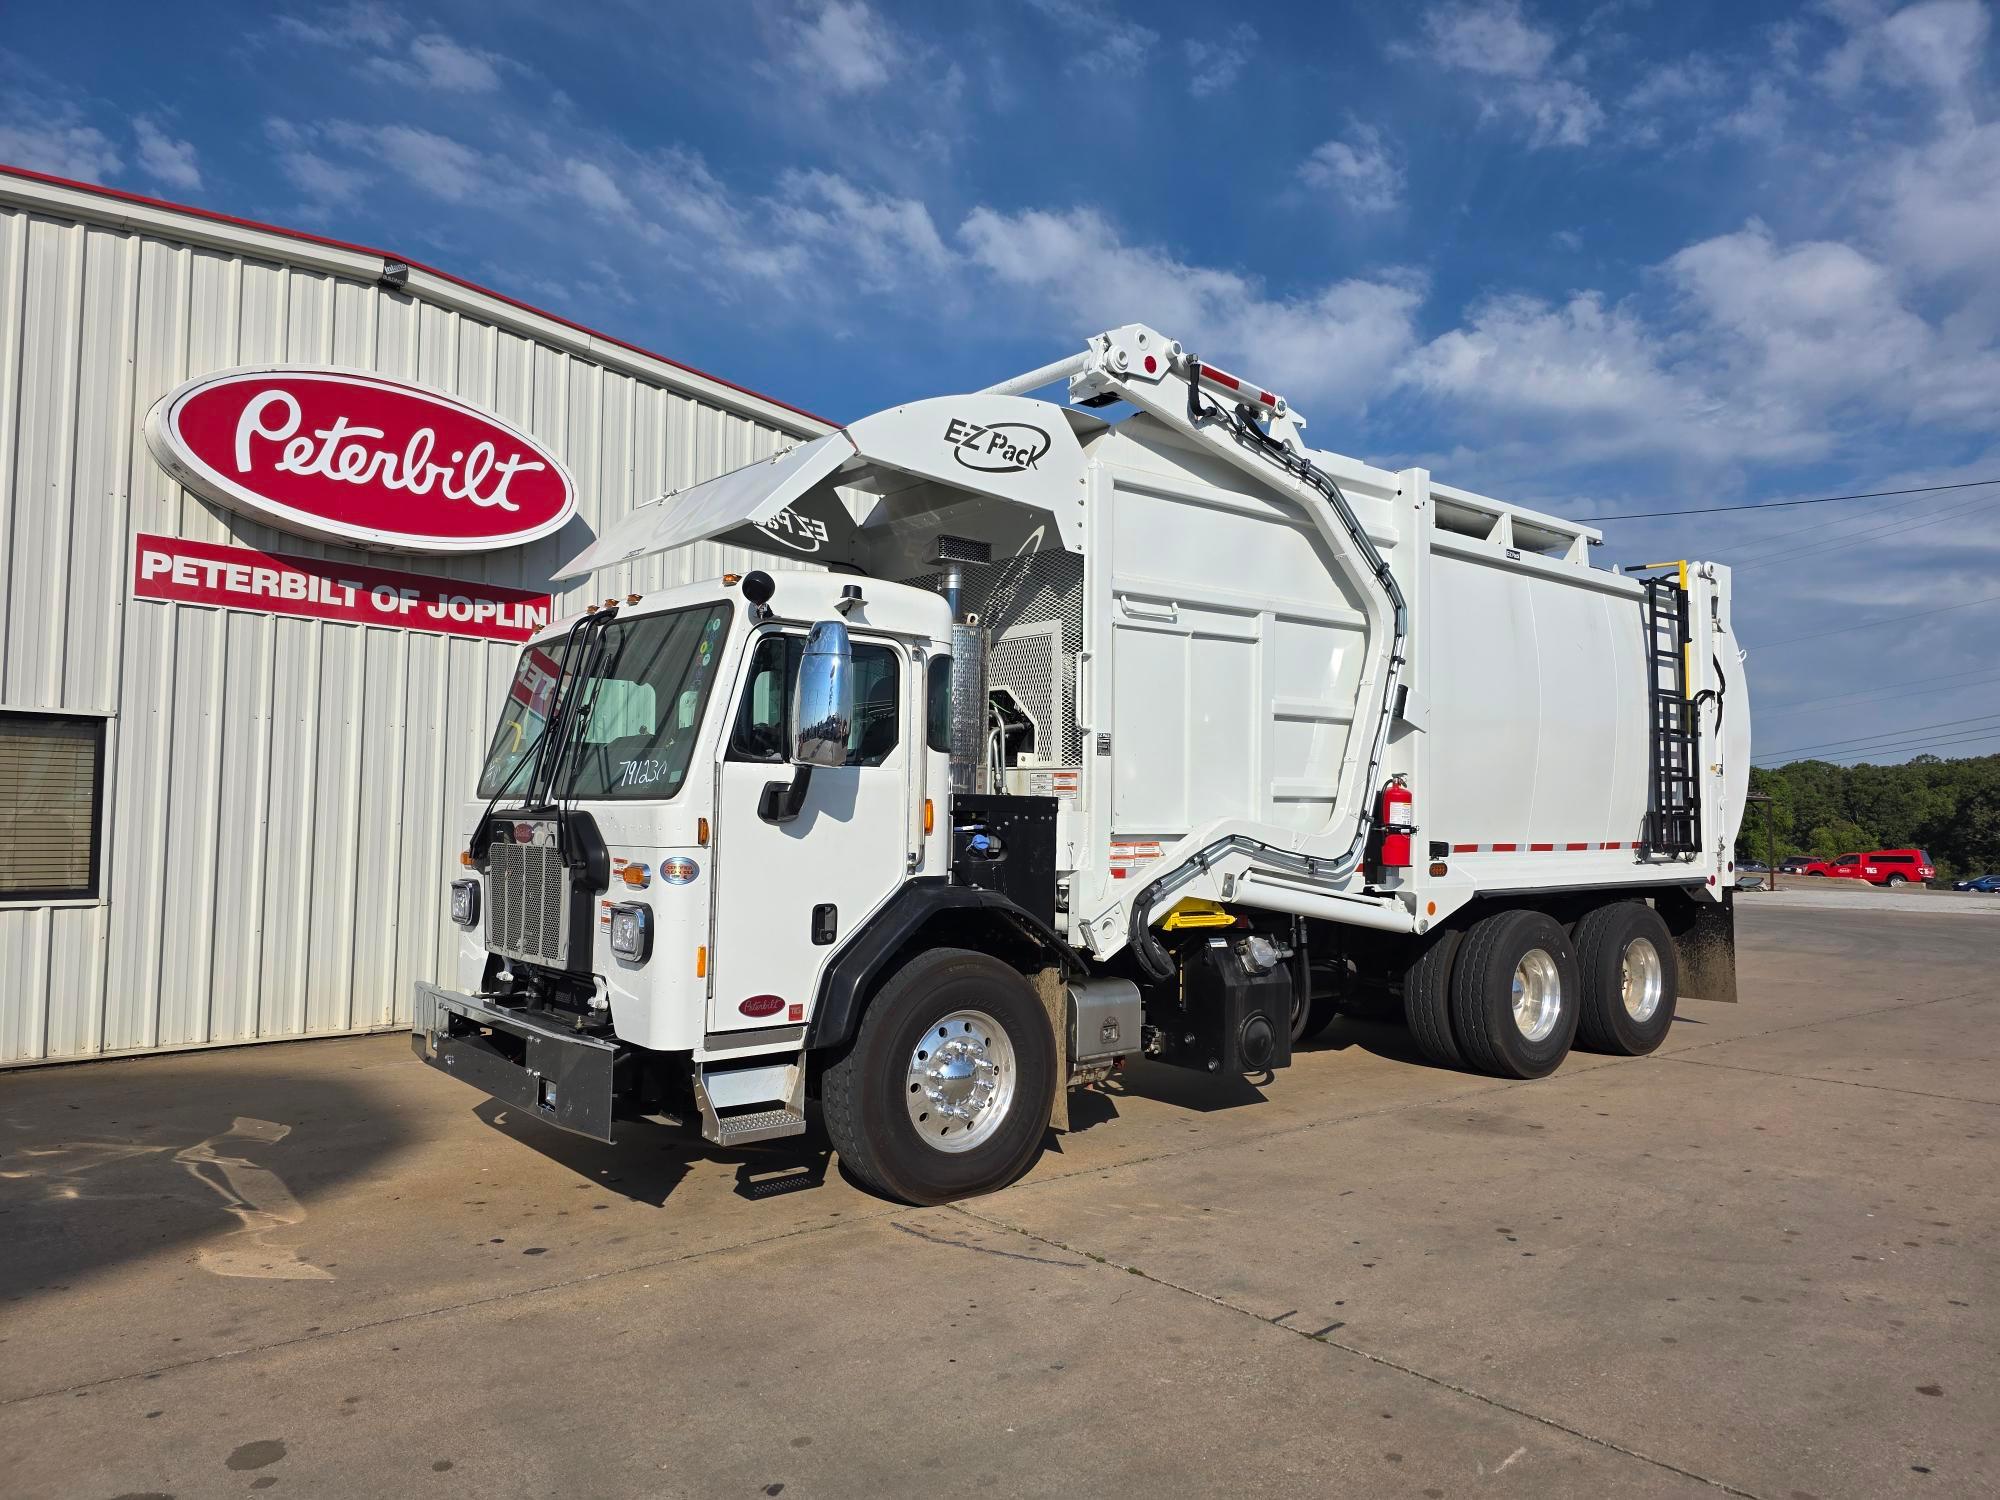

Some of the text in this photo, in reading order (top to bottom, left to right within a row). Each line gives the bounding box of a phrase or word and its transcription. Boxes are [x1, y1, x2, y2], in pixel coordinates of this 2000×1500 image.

[235, 389, 545, 511] Peterbilt
[986, 431, 1039, 471] Pack
[141, 550, 547, 629] PETERBILT OF JOPLIN
